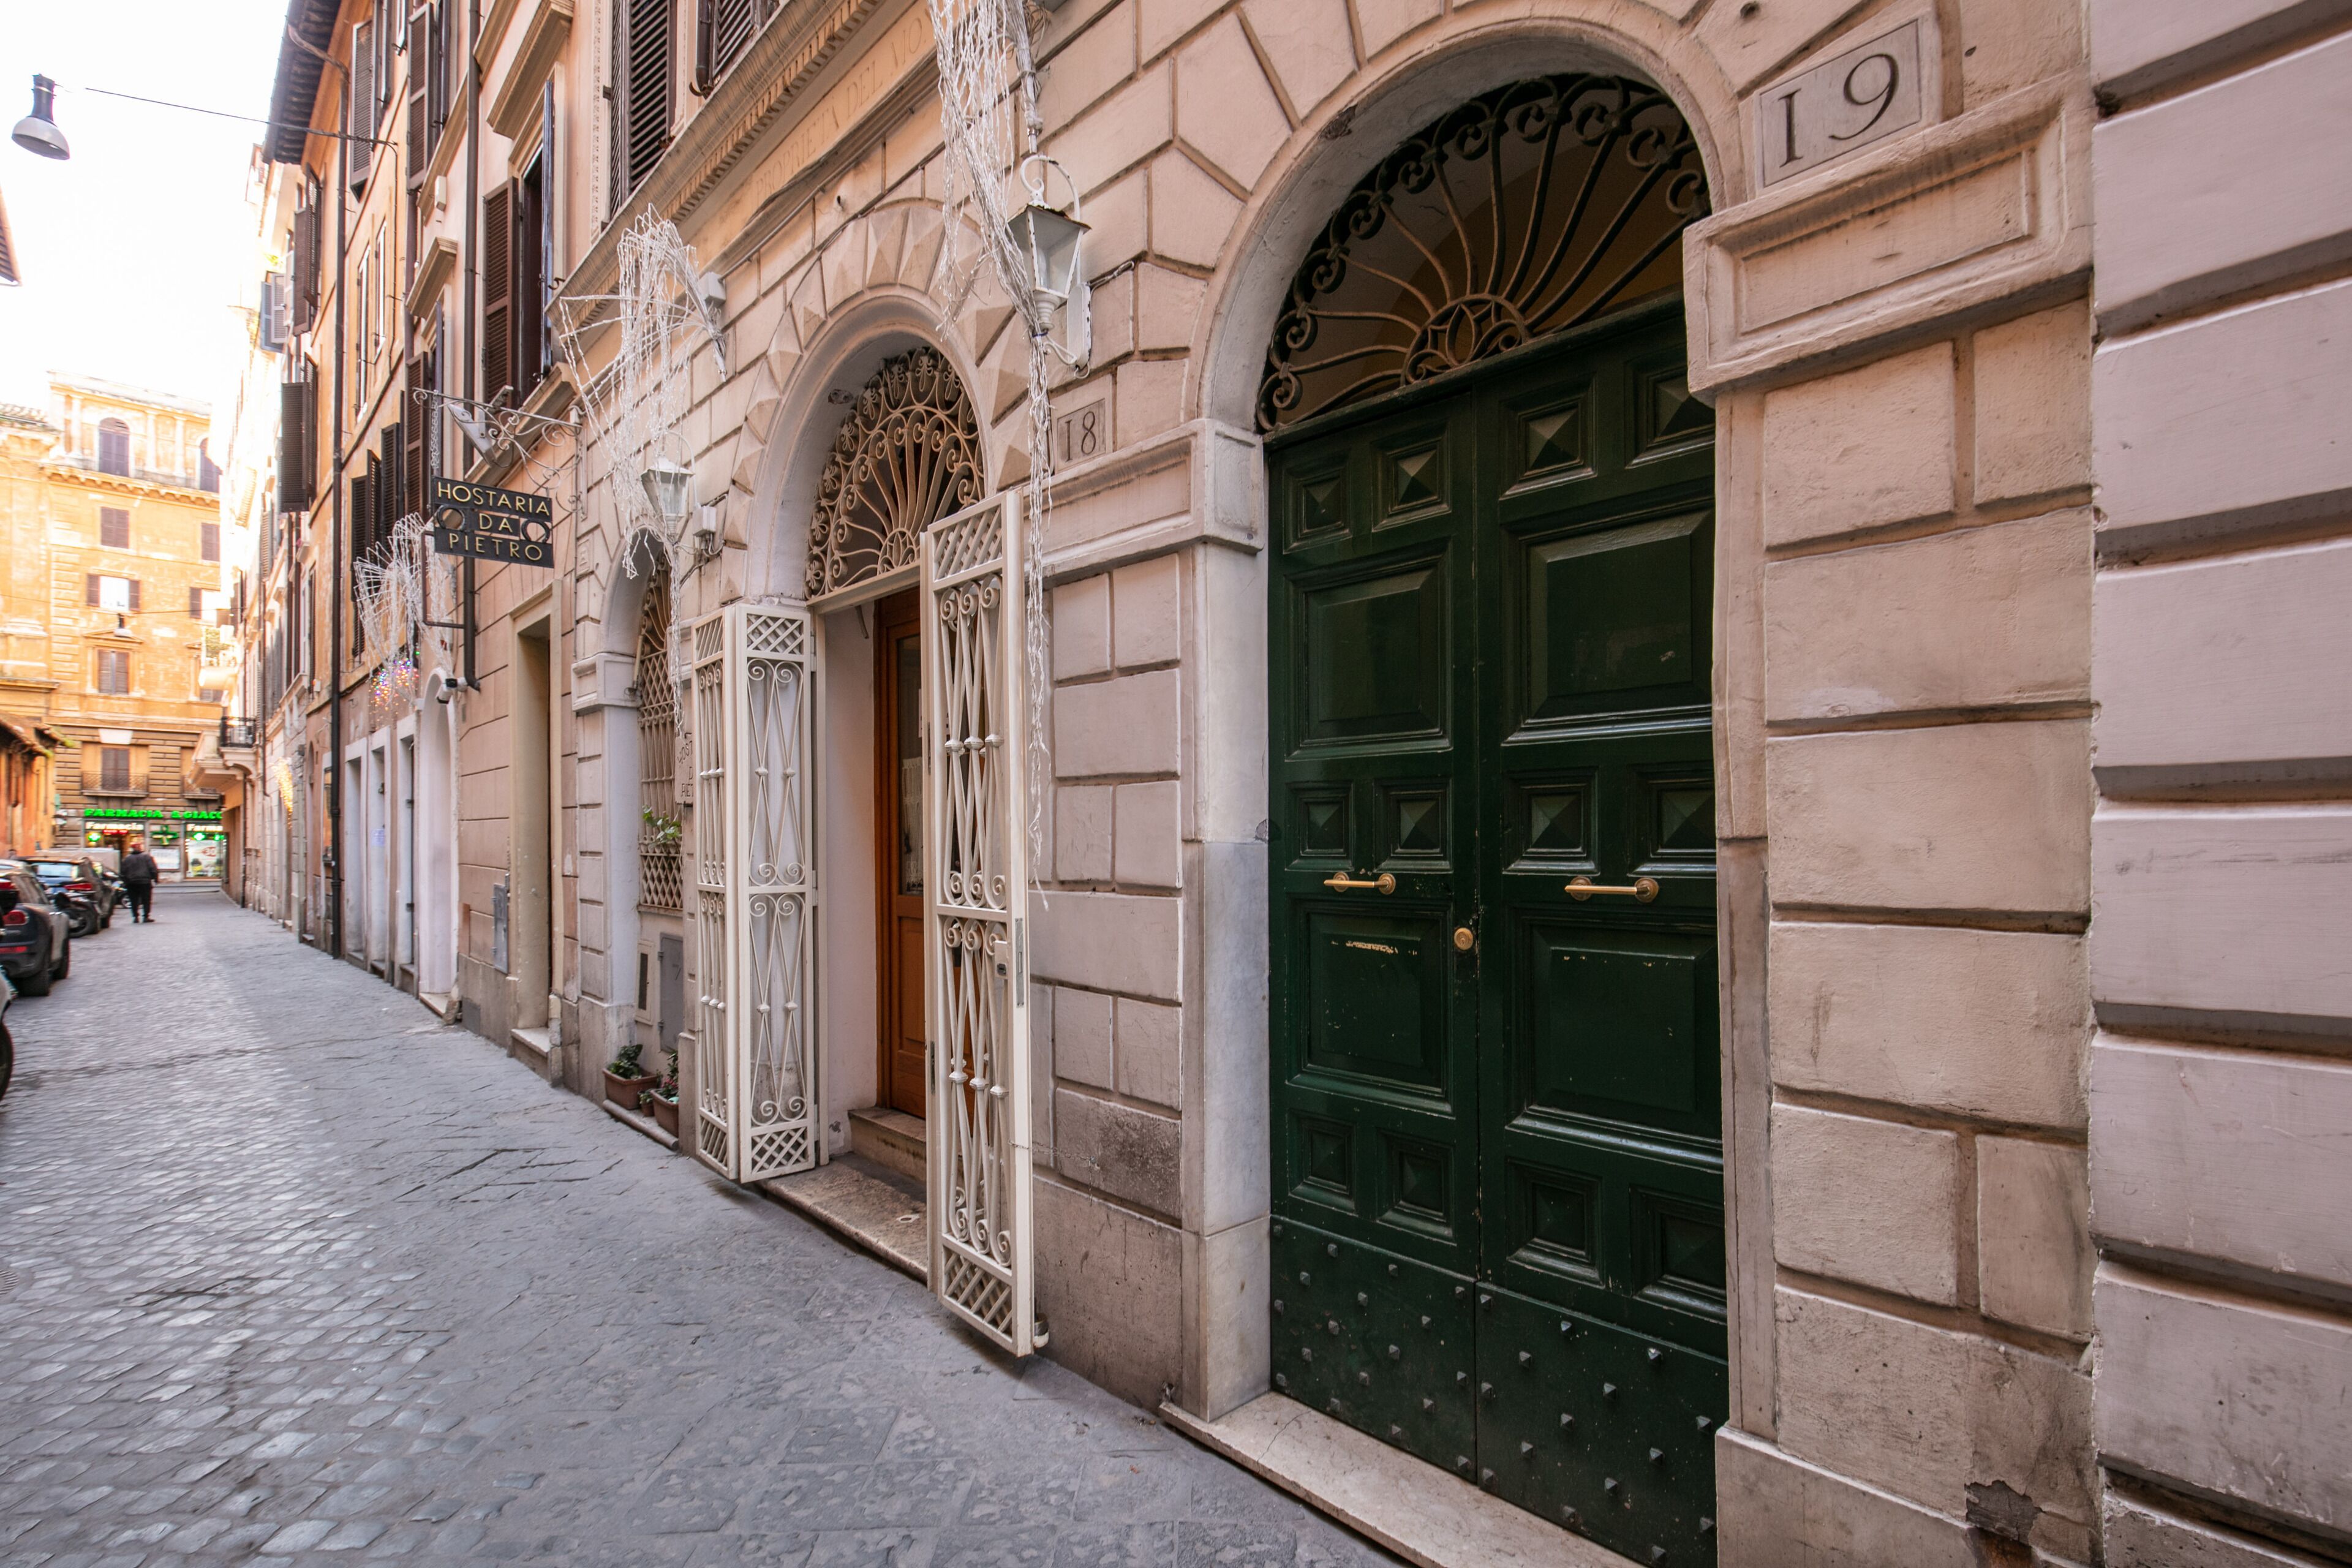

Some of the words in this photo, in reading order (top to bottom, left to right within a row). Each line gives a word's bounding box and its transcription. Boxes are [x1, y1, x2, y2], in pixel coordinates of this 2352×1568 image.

[1777, 53, 1899, 168] 19
[1065, 411, 1096, 463] 18
[438, 481, 549, 516] HOSTARIA
[479, 513, 513, 533] DA
[449, 533, 542, 560] PIETRO
[84, 809, 164, 818] FARMACIA
[86, 821, 144, 831] Farmacia
